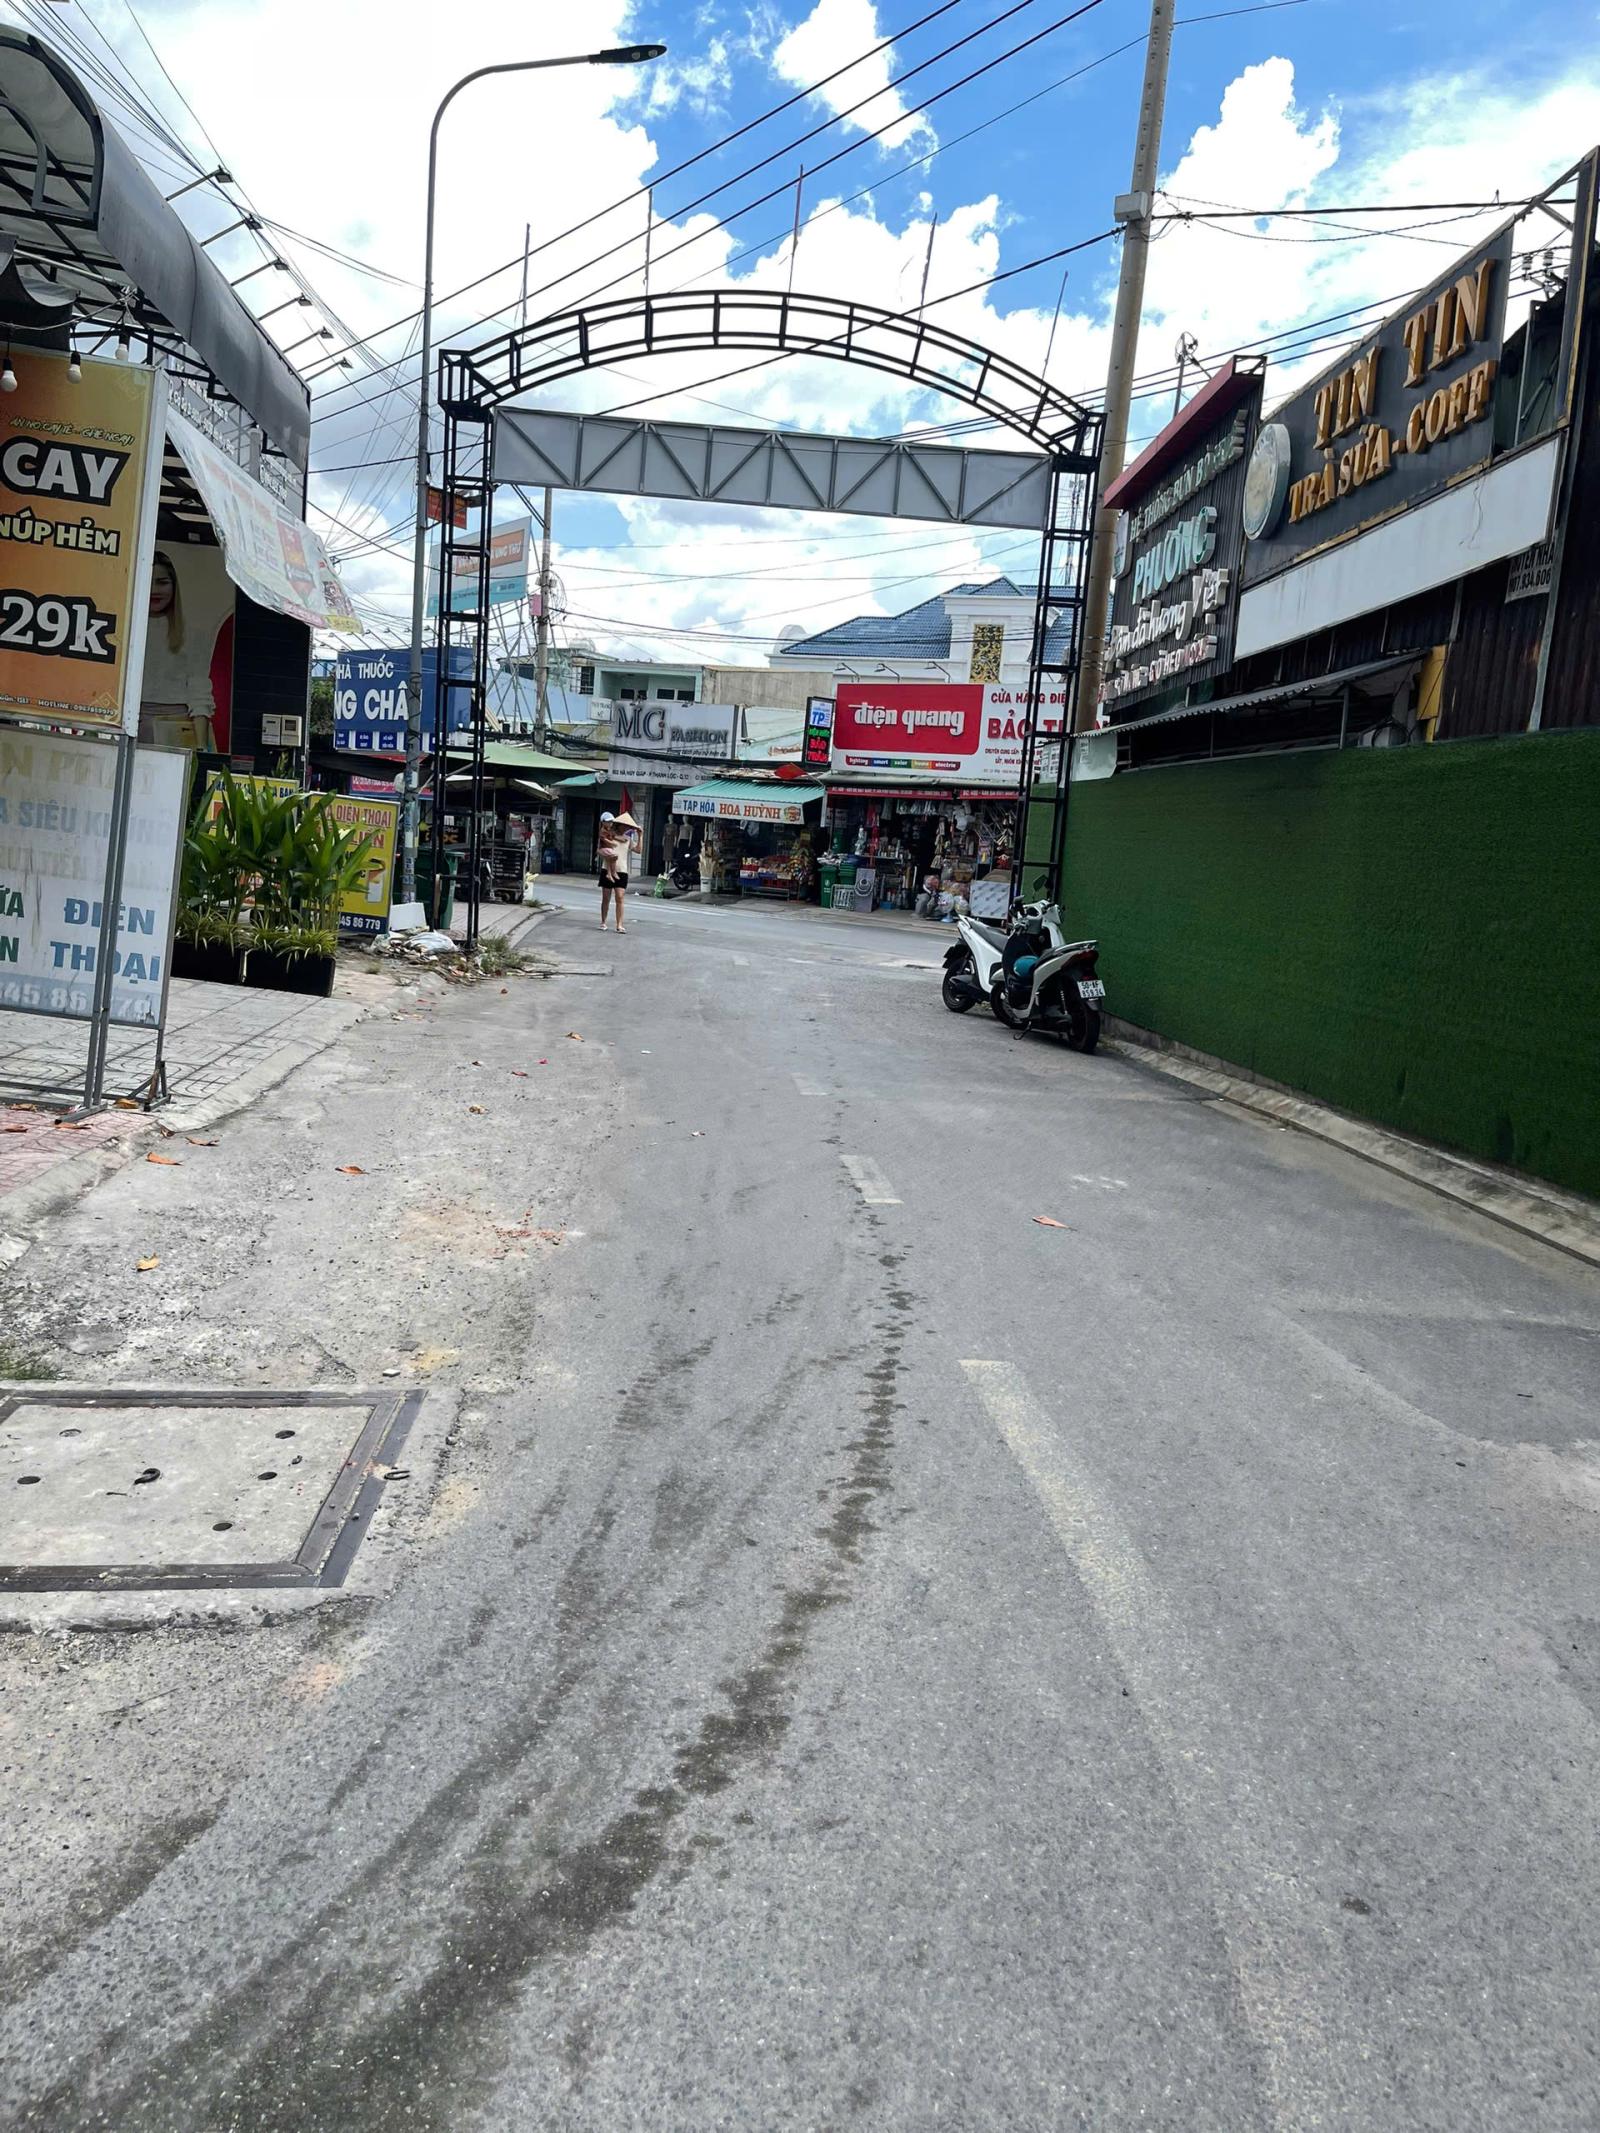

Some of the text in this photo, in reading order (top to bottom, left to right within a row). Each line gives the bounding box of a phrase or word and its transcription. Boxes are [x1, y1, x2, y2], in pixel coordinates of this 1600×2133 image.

[1313, 259, 1496, 449] TIN TIN
[2, 441, 120, 500] CAY
[1289, 448, 1336, 523] TRÀ
[56, 518, 119, 555] HẺM
[1, 596, 108, 656] 29k
[359, 653, 394, 680] THUỐC
[991, 688, 1012, 704] CỬA
[616, 704, 666, 741] MG
[849, 702, 965, 736] điện quang
[683, 800, 698, 814] TẠP
[700, 799, 716, 814] HÓA
[719, 803, 741, 816] HOA
